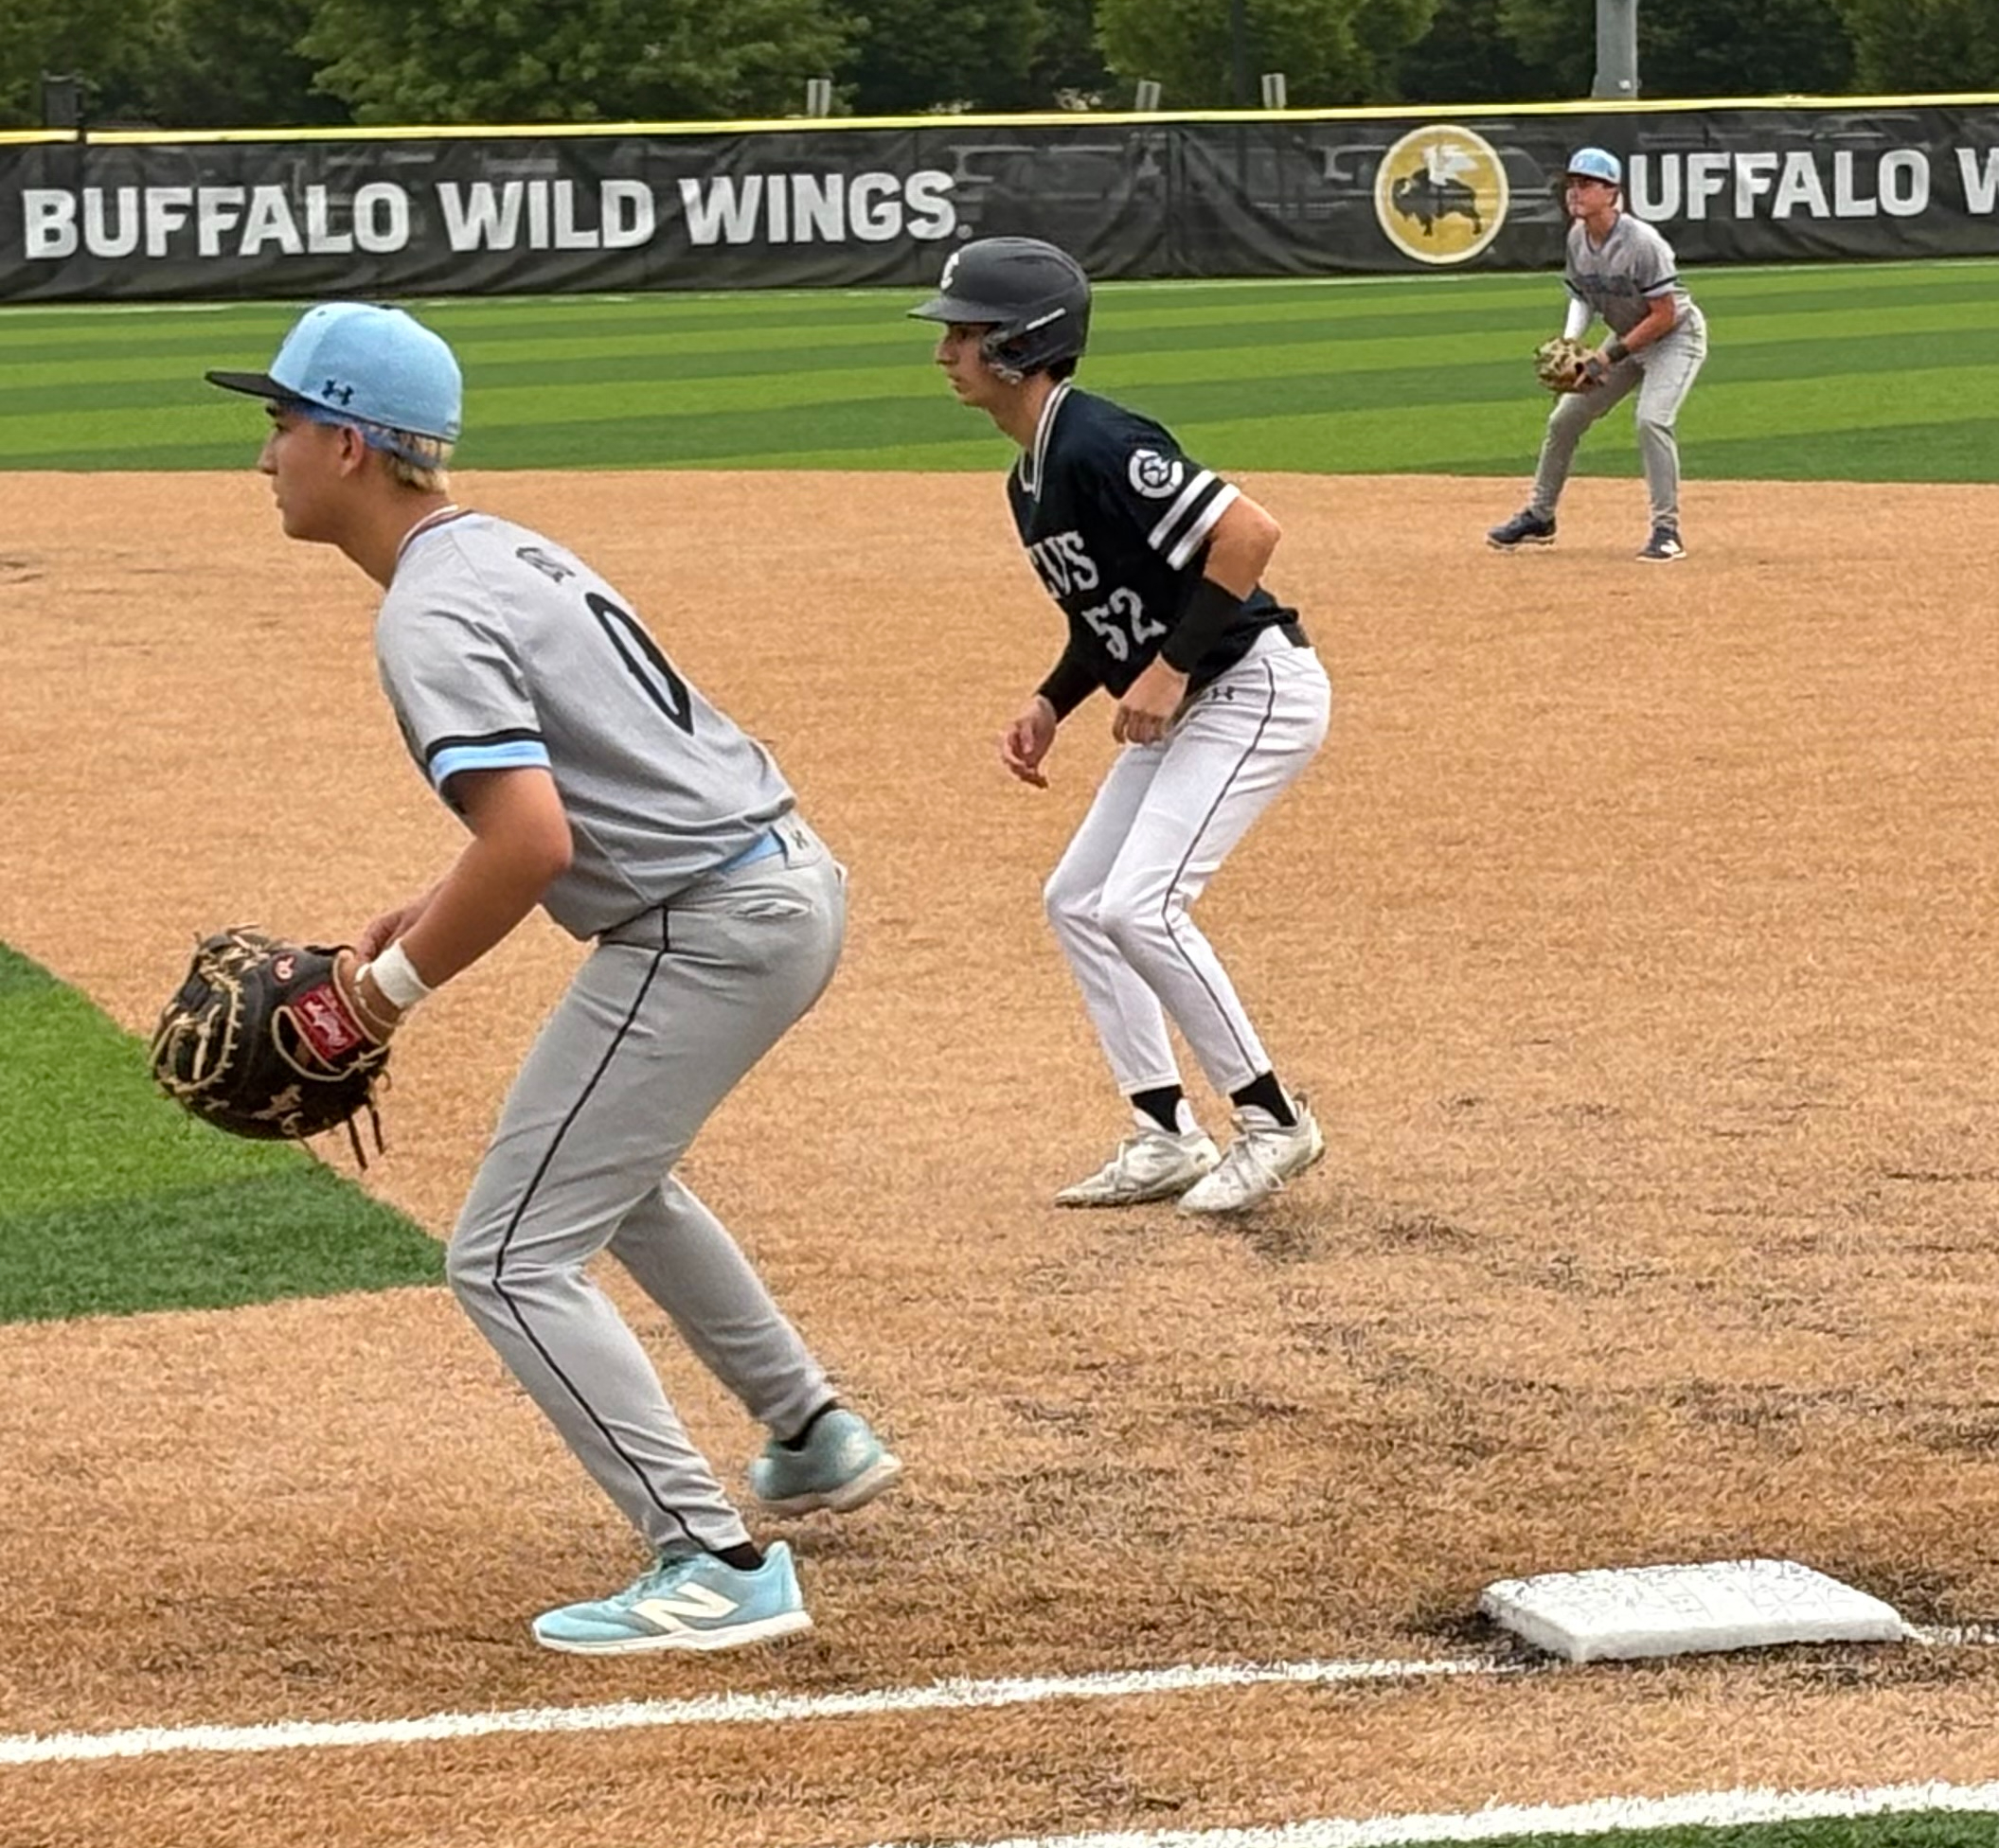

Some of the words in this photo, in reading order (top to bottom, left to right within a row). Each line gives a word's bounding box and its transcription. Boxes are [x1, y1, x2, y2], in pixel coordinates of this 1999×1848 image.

[23, 182, 410, 259] BUFFALO
[436, 179, 656, 253] WILD
[678, 169, 957, 246] WINGS
[1614, 148, 1930, 222] UFFALO
[584, 592, 695, 737] 0
[1081, 586, 1168, 662] 52
